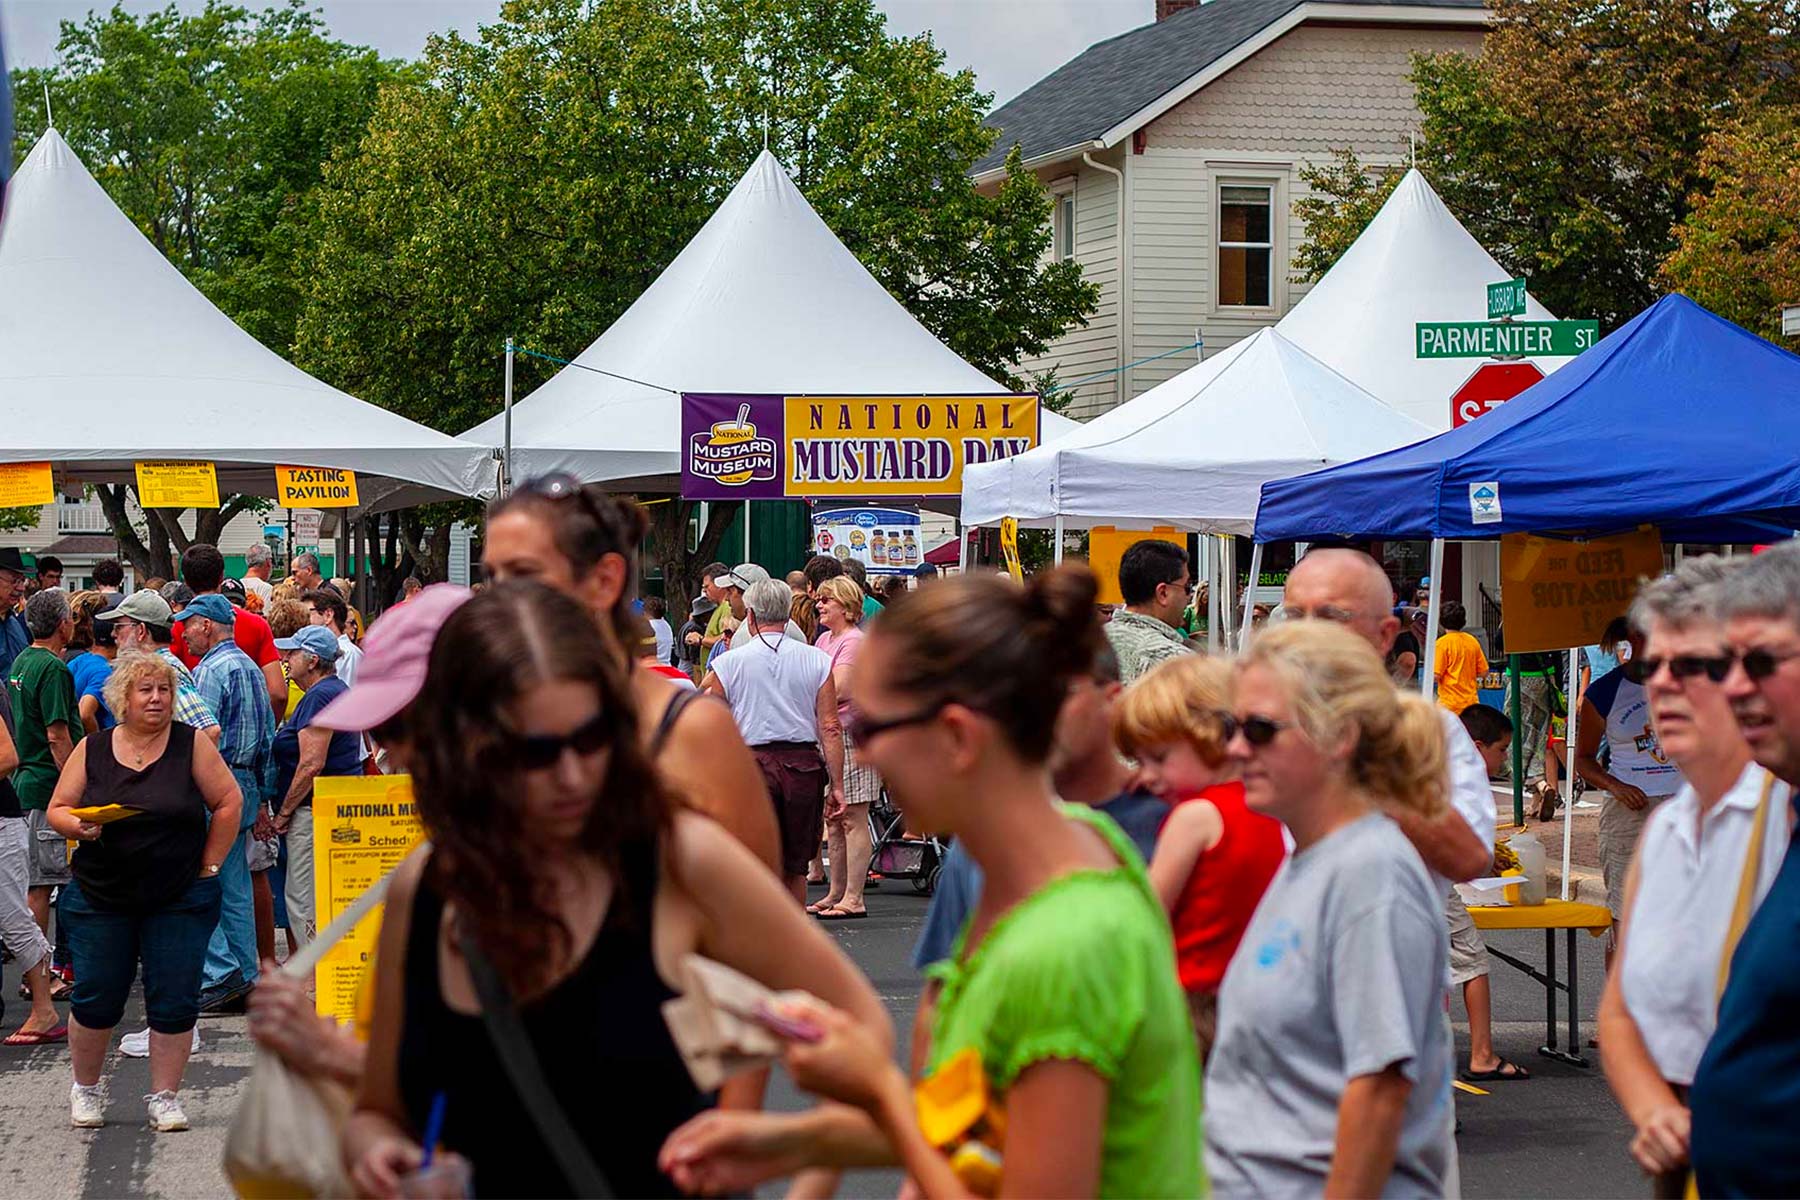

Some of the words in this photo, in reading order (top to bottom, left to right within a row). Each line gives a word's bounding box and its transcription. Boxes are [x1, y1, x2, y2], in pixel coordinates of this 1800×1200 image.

[1420, 326, 1553, 353] PARMENTER
[1575, 328, 1595, 348] ST
[809, 404, 1013, 430] NATIONAL
[716, 430, 752, 438] NATIONAL
[694, 441, 772, 458] MUSTARD
[694, 457, 772, 475] MUSEUM
[794, 439, 952, 481] MUSTARD
[288, 470, 345, 483] TASTING
[286, 486, 350, 499] PAVILION
[337, 803, 395, 818] NATIONAL
